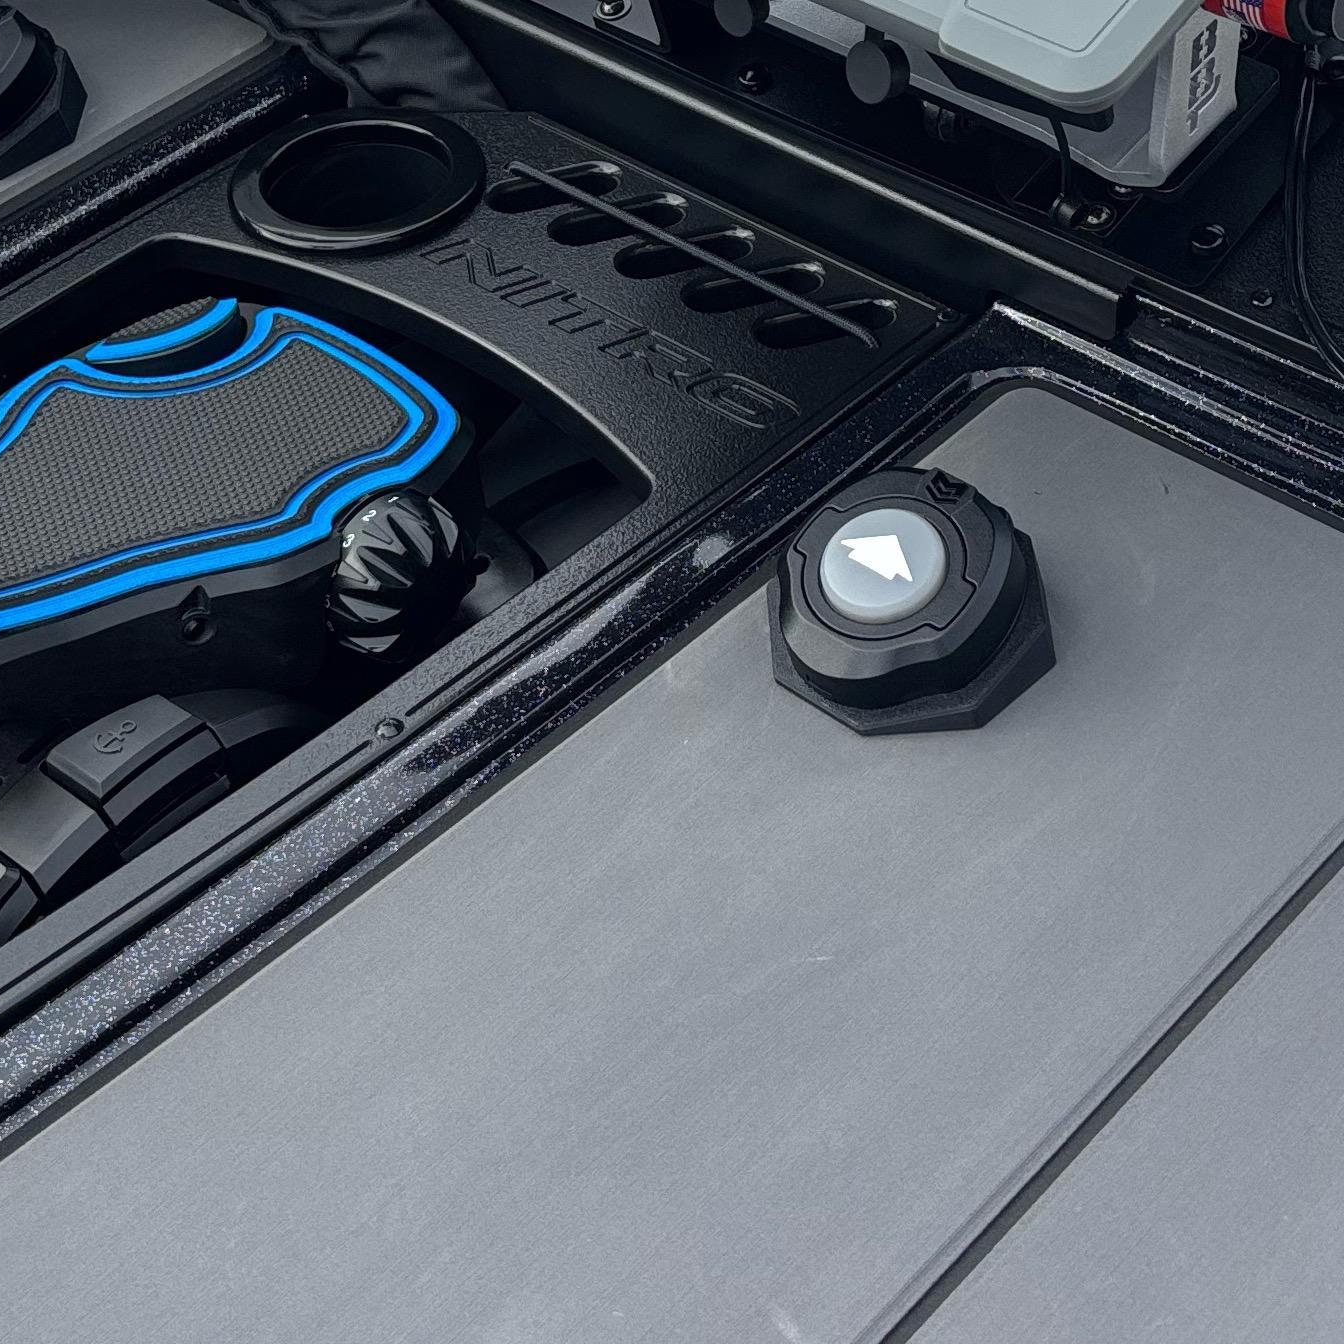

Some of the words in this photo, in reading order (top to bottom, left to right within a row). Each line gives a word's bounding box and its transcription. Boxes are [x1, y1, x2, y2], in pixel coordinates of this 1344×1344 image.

[419, 238, 801, 429] NITRO
[361, 509, 377, 522] 2
[342, 533, 355, 548] 3
